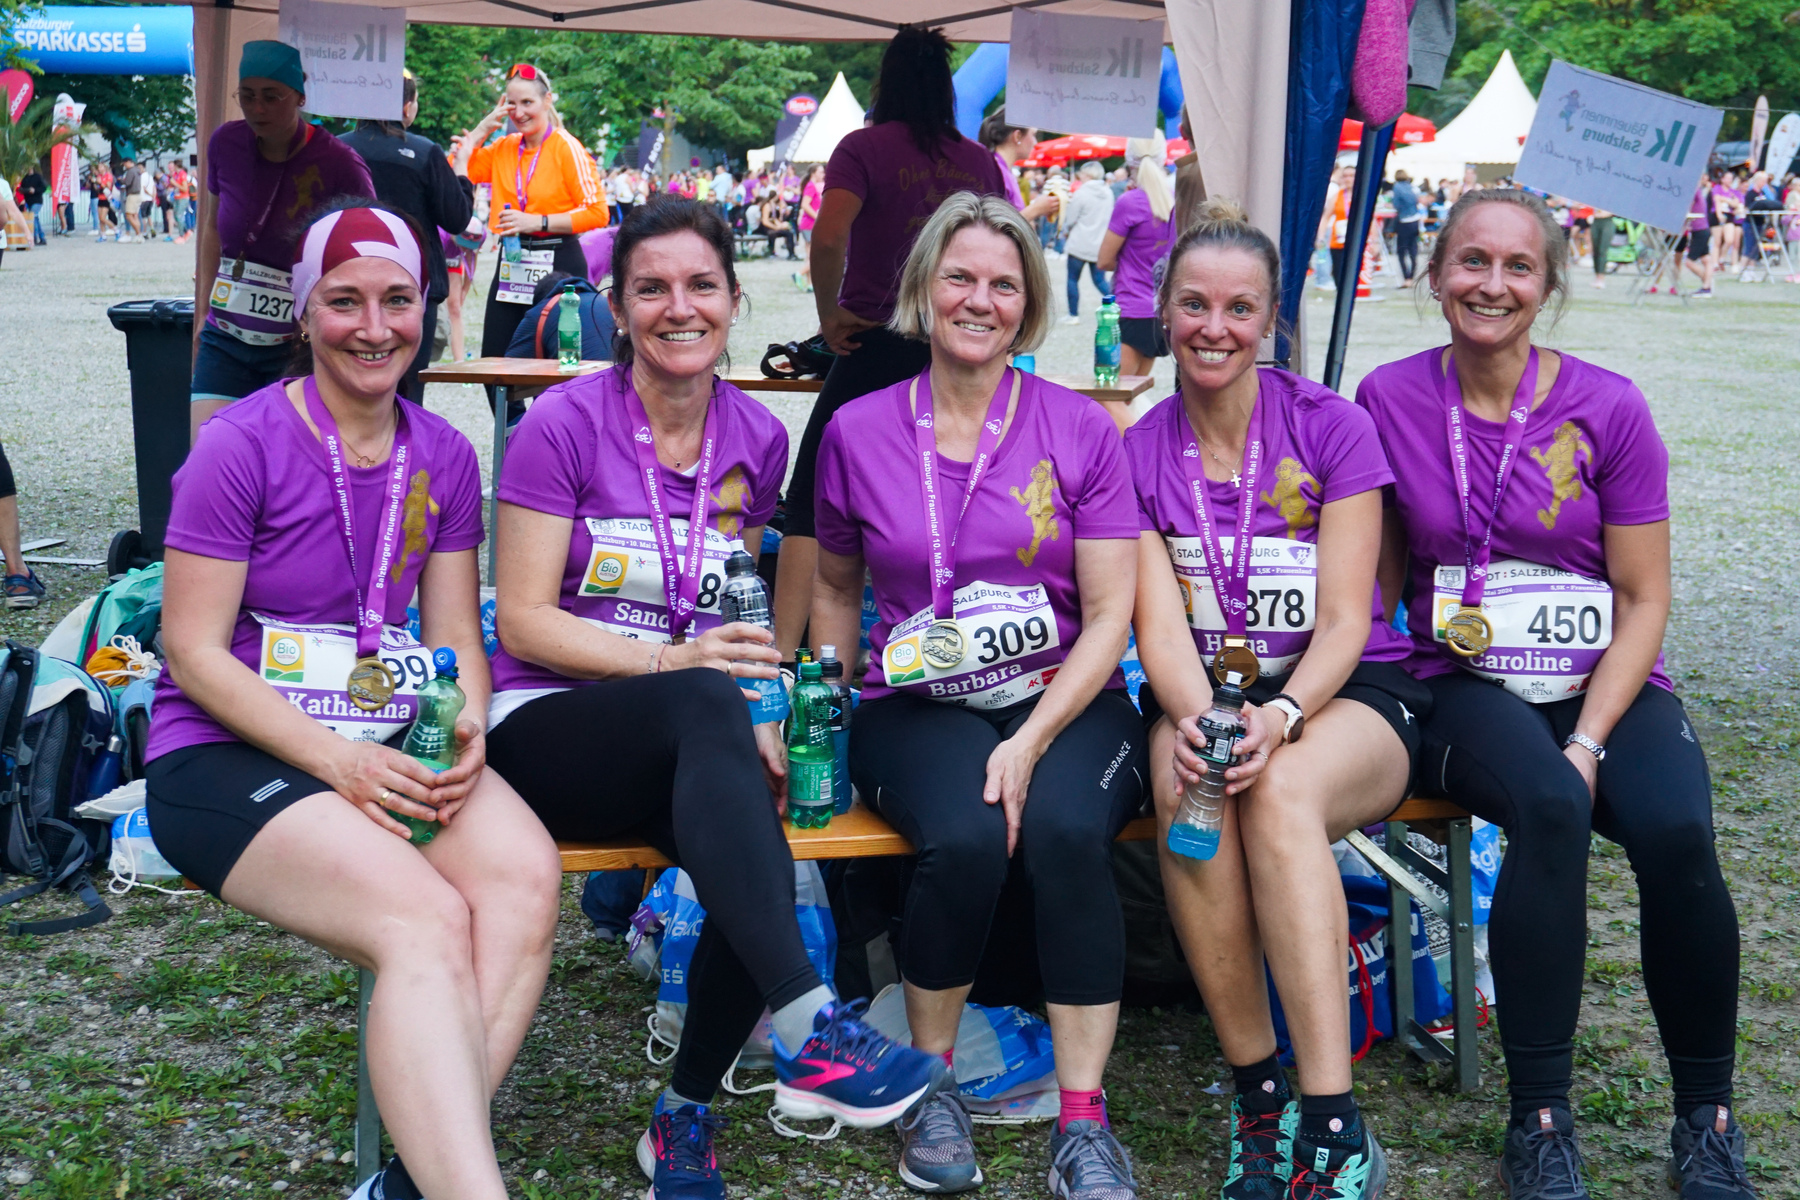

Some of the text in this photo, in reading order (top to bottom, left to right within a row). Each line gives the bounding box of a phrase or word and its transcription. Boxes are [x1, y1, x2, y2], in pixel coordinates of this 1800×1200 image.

[14, 31, 125, 52] SPARKASSE
[509, 283, 535, 293] Corinn
[249, 293, 294, 320] 1237
[1451, 406, 1461, 425] 2024
[326, 435, 339, 455] 2024
[705, 438, 713, 458] 2024
[1455, 441, 1464, 453] 10.
[923, 450, 934, 493] Salzburger
[968, 452, 987, 494] Salzburger
[1456, 453, 1470, 497] Frauenlauf
[1497, 443, 1514, 487] Salzburger
[335, 474, 344, 488] 10.
[700, 475, 708, 487] 10.
[1247, 476, 1255, 488] 10.
[376, 542, 391, 589] Salzburger
[384, 495, 400, 541] Frauenlauf
[392, 482, 402, 493] 10.
[397, 445, 407, 463] 2024
[646, 467, 661, 514] Salzburger
[656, 514, 672, 559] Frauenlauf
[666, 560, 674, 574] 10.
[694, 487, 706, 535] Frauenlauf
[928, 494, 940, 537] Frauenlauf
[1242, 489, 1253, 533] Frauenlauf
[619, 521, 720, 543] STADT ALZRG
[1192, 480, 1207, 521] Salzburger
[1202, 522, 1217, 564] Frauenlauf
[1212, 566, 1222, 578] 10.
[598, 536, 625, 547] Salzburg
[688, 536, 701, 578] Salzburger
[1177, 548, 1280, 559] STAD SABURG
[1236, 533, 1249, 578] Salzburger
[601, 561, 619, 574] Bio
[1510, 568, 1574, 578] SALZBURG
[953, 589, 1012, 606] SALZBURG
[614, 602, 696, 633] Sanda
[1447, 607, 1458, 615] Bi
[1528, 605, 1600, 645] 450
[277, 642, 296, 655] Bio
[974, 616, 1049, 664] 309
[1204, 633, 1269, 654] Hga
[894, 648, 912, 659] Bio
[1469, 651, 1573, 672] Caroline
[928, 664, 1023, 697] Barbara
[1027, 677, 1040, 690] AK
[1566, 684, 1578, 693] AK
[985, 692, 1015, 706] FESTINA
[1100, 741, 1131, 790] ENDURANCE
